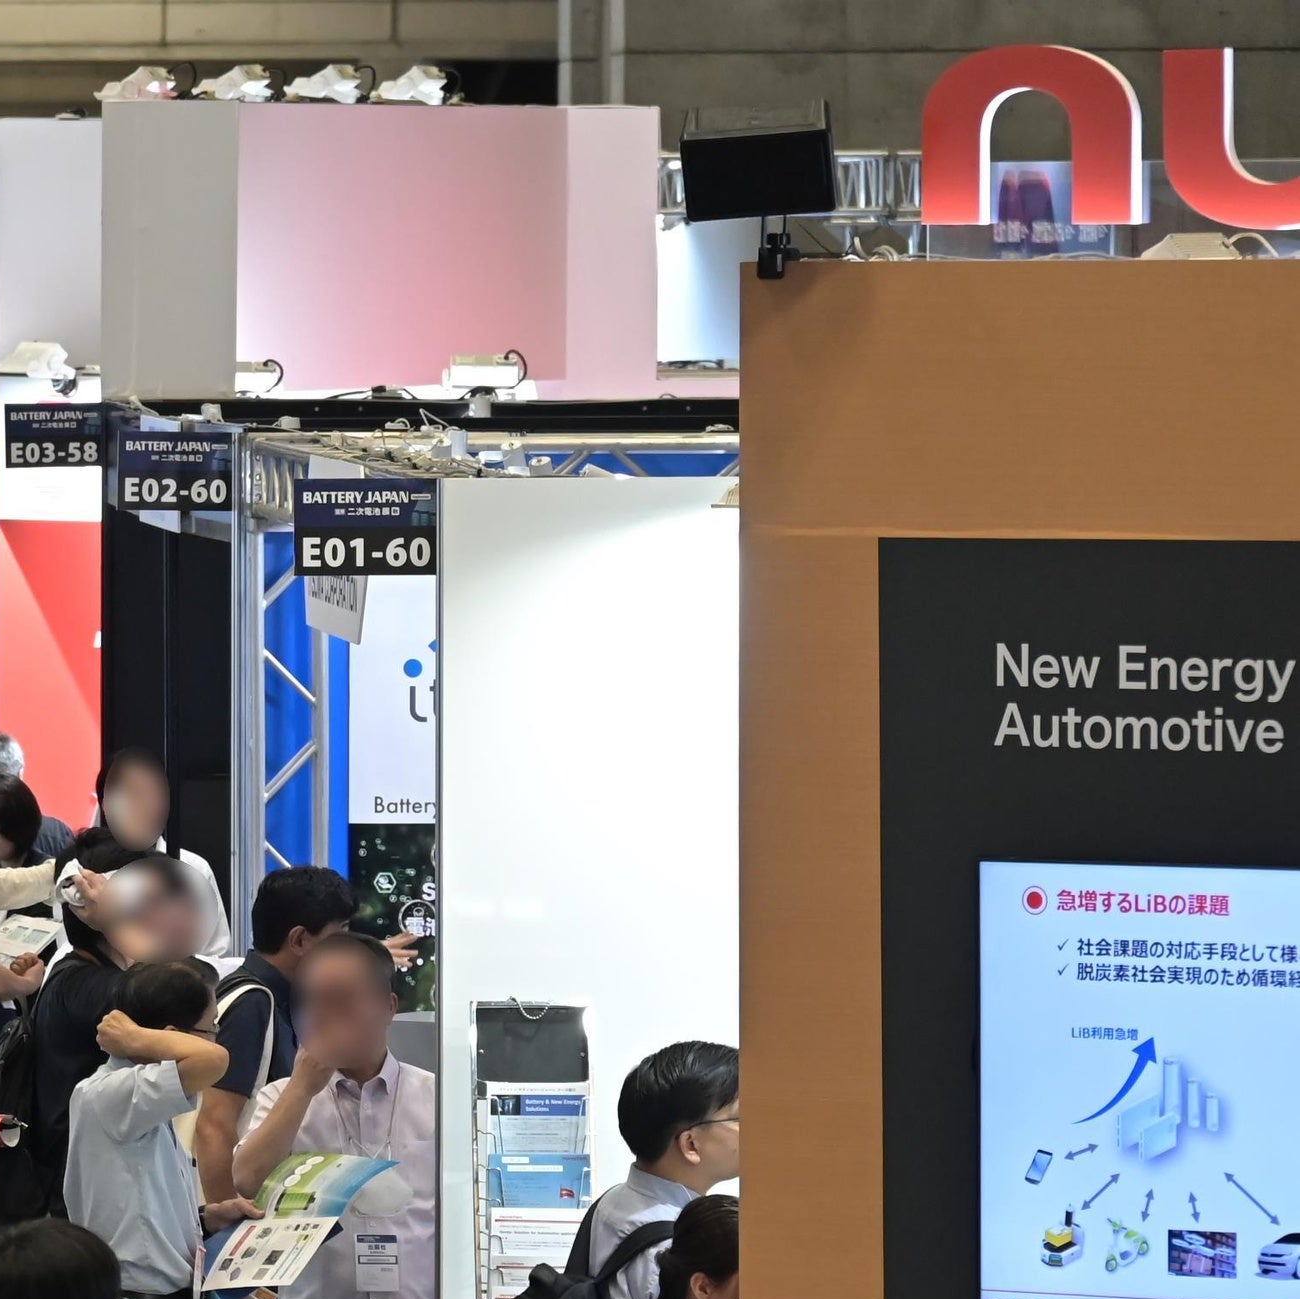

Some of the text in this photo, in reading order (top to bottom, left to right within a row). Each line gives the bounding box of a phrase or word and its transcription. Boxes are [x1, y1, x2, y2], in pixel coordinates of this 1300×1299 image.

[10, 410, 83, 422] BATTERY JAPAN
[10, 442, 98, 464] E03-58
[125, 440, 211, 452] BATTERY JAPAN
[124, 477, 227, 504] E02-60
[302, 491, 364, 504] BATTERY
[364, 491, 409, 503] JAPAN
[302, 537, 431, 568] E01-60
[996, 642, 1296, 703] New Energy
[994, 702, 1285, 754] Automotive
[1056, 889, 1230, 917] 急増するLiBの課題
[1071, 1026, 1139, 1042] LiB利用急増
